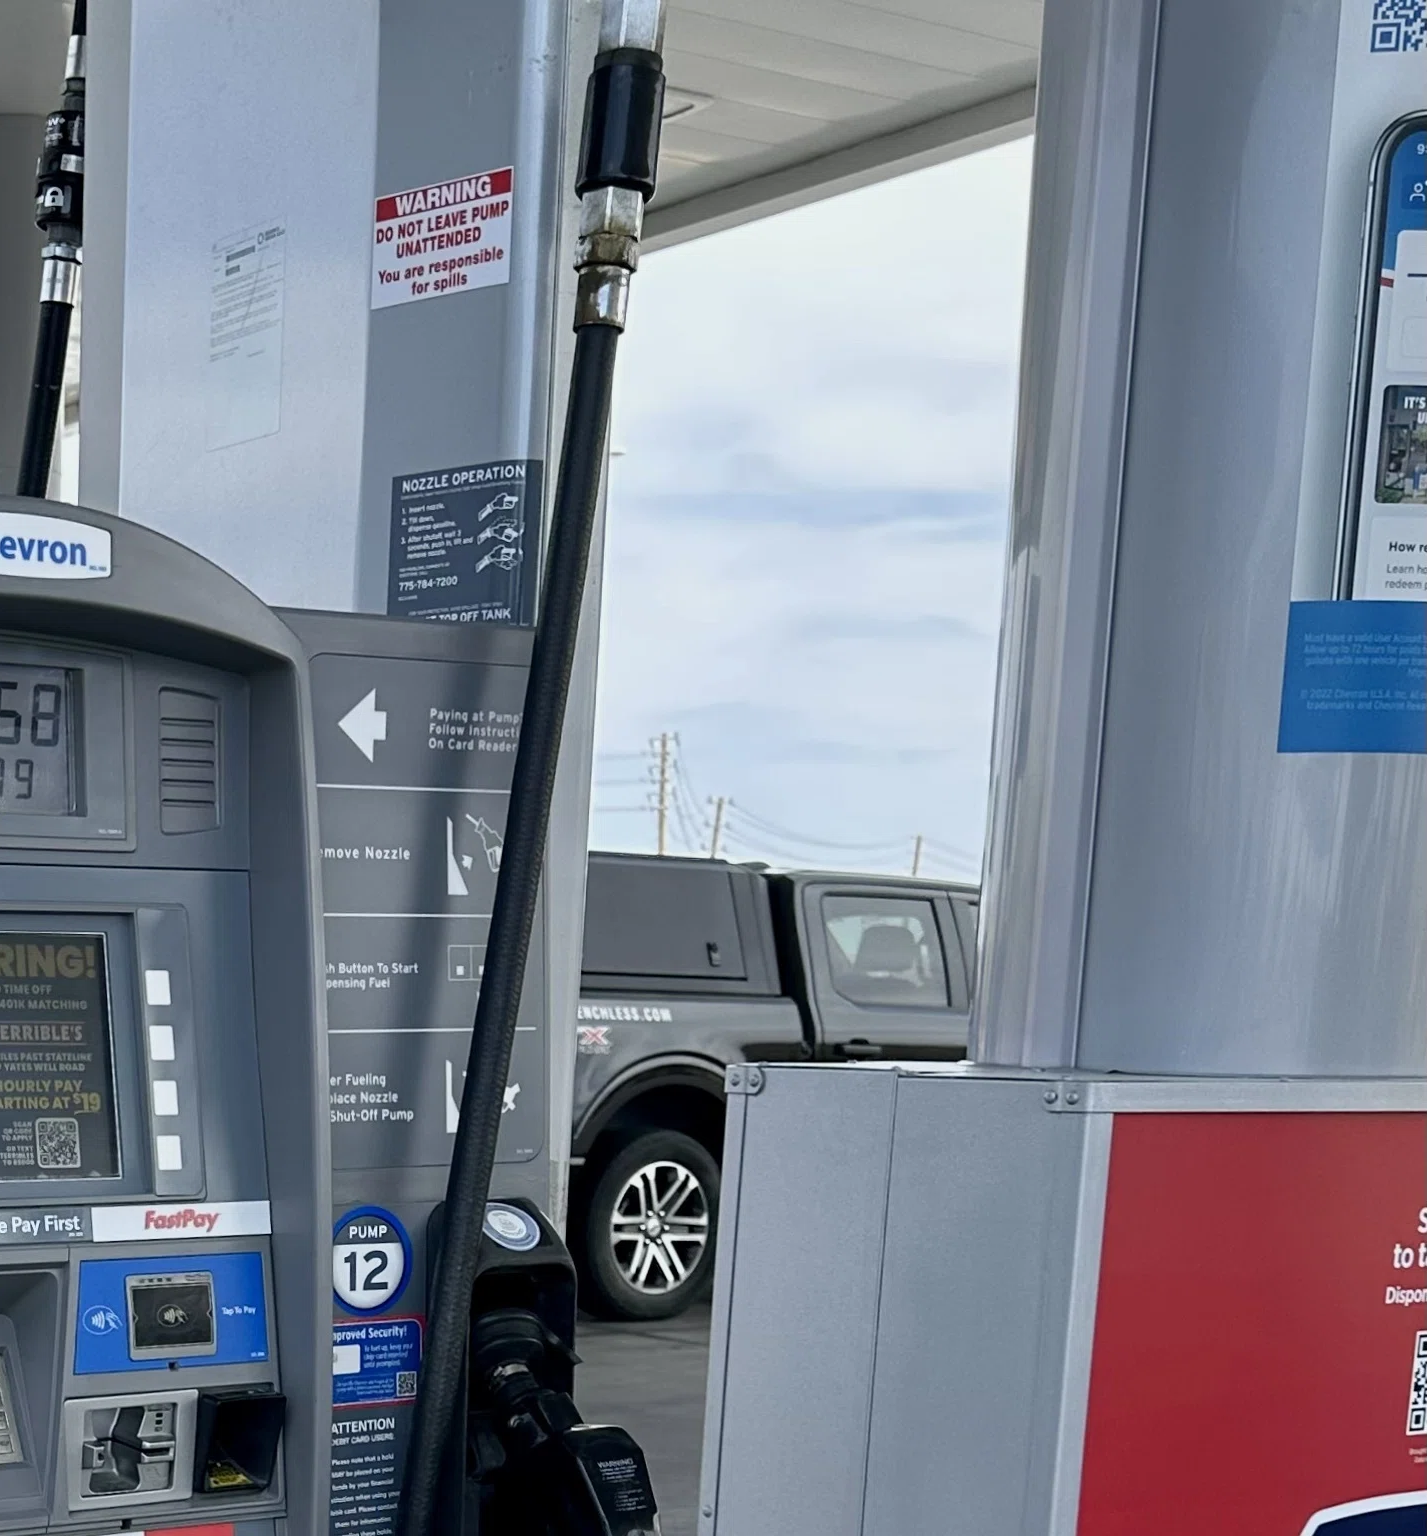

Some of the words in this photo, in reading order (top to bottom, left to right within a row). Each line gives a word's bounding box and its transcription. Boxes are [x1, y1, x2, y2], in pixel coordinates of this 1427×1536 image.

[395, 176, 491, 216] WARNING
[376, 228, 393, 244] DO
[397, 221, 423, 239] NOT
[427, 210, 467, 232] LEAVE
[472, 201, 509, 222] PUMP
[396, 227, 481, 258] UNATTENDED
[379, 269, 400, 285] You
[405, 264, 424, 279] are
[429, 248, 503, 276] responsible
[412, 281, 429, 295] for
[434, 272, 467, 294] spills
[402, 475, 449, 493] NOZZLE
[452, 465, 525, 485] OPERATION
[1389, 542, 1415, 553] How
[1387, 563, 1415, 574] Learn
[1385, 579, 1421, 590] redeem
[460, 611, 478, 622] OFF
[482, 608, 511, 620] TANK
[430, 708, 468, 723] Paying
[472, 713, 484, 721] at
[430, 724, 464, 735] Follow
[429, 738, 444, 749] On
[448, 740, 474, 751] Card
[479, 741, 516, 752] Reader
[366, 846, 410, 860] Nozzle
[339, 963, 374, 974] Button
[377, 963, 390, 974] To
[392, 963, 418, 974] Start
[3, 984, 29, 994] TIME
[32, 985, 52, 995] OFF
[369, 977, 390, 988] Fuel
[28, 1000, 87, 1010] MATCHING
[578, 1005, 672, 1022] ENCHLESS.COM
[346, 1073, 386, 1088] Fueling
[360, 1091, 398, 1104] Nozzle
[382, 1109, 413, 1122] Pump
[12, 1217, 40, 1236] Pay
[44, 1215, 81, 1232] First
[144, 1210, 219, 1232] FastPay
[349, 1225, 387, 1239] PUMP
[1393, 1243, 1414, 1268] to
[344, 1250, 388, 1291] 12
[222, 1306, 234, 1316] Tap
[236, 1306, 242, 1314] To
[244, 1305, 256, 1315] Pay
[368, 1325, 407, 1339] Security!
[332, 1417, 395, 1435] ATTENTION
